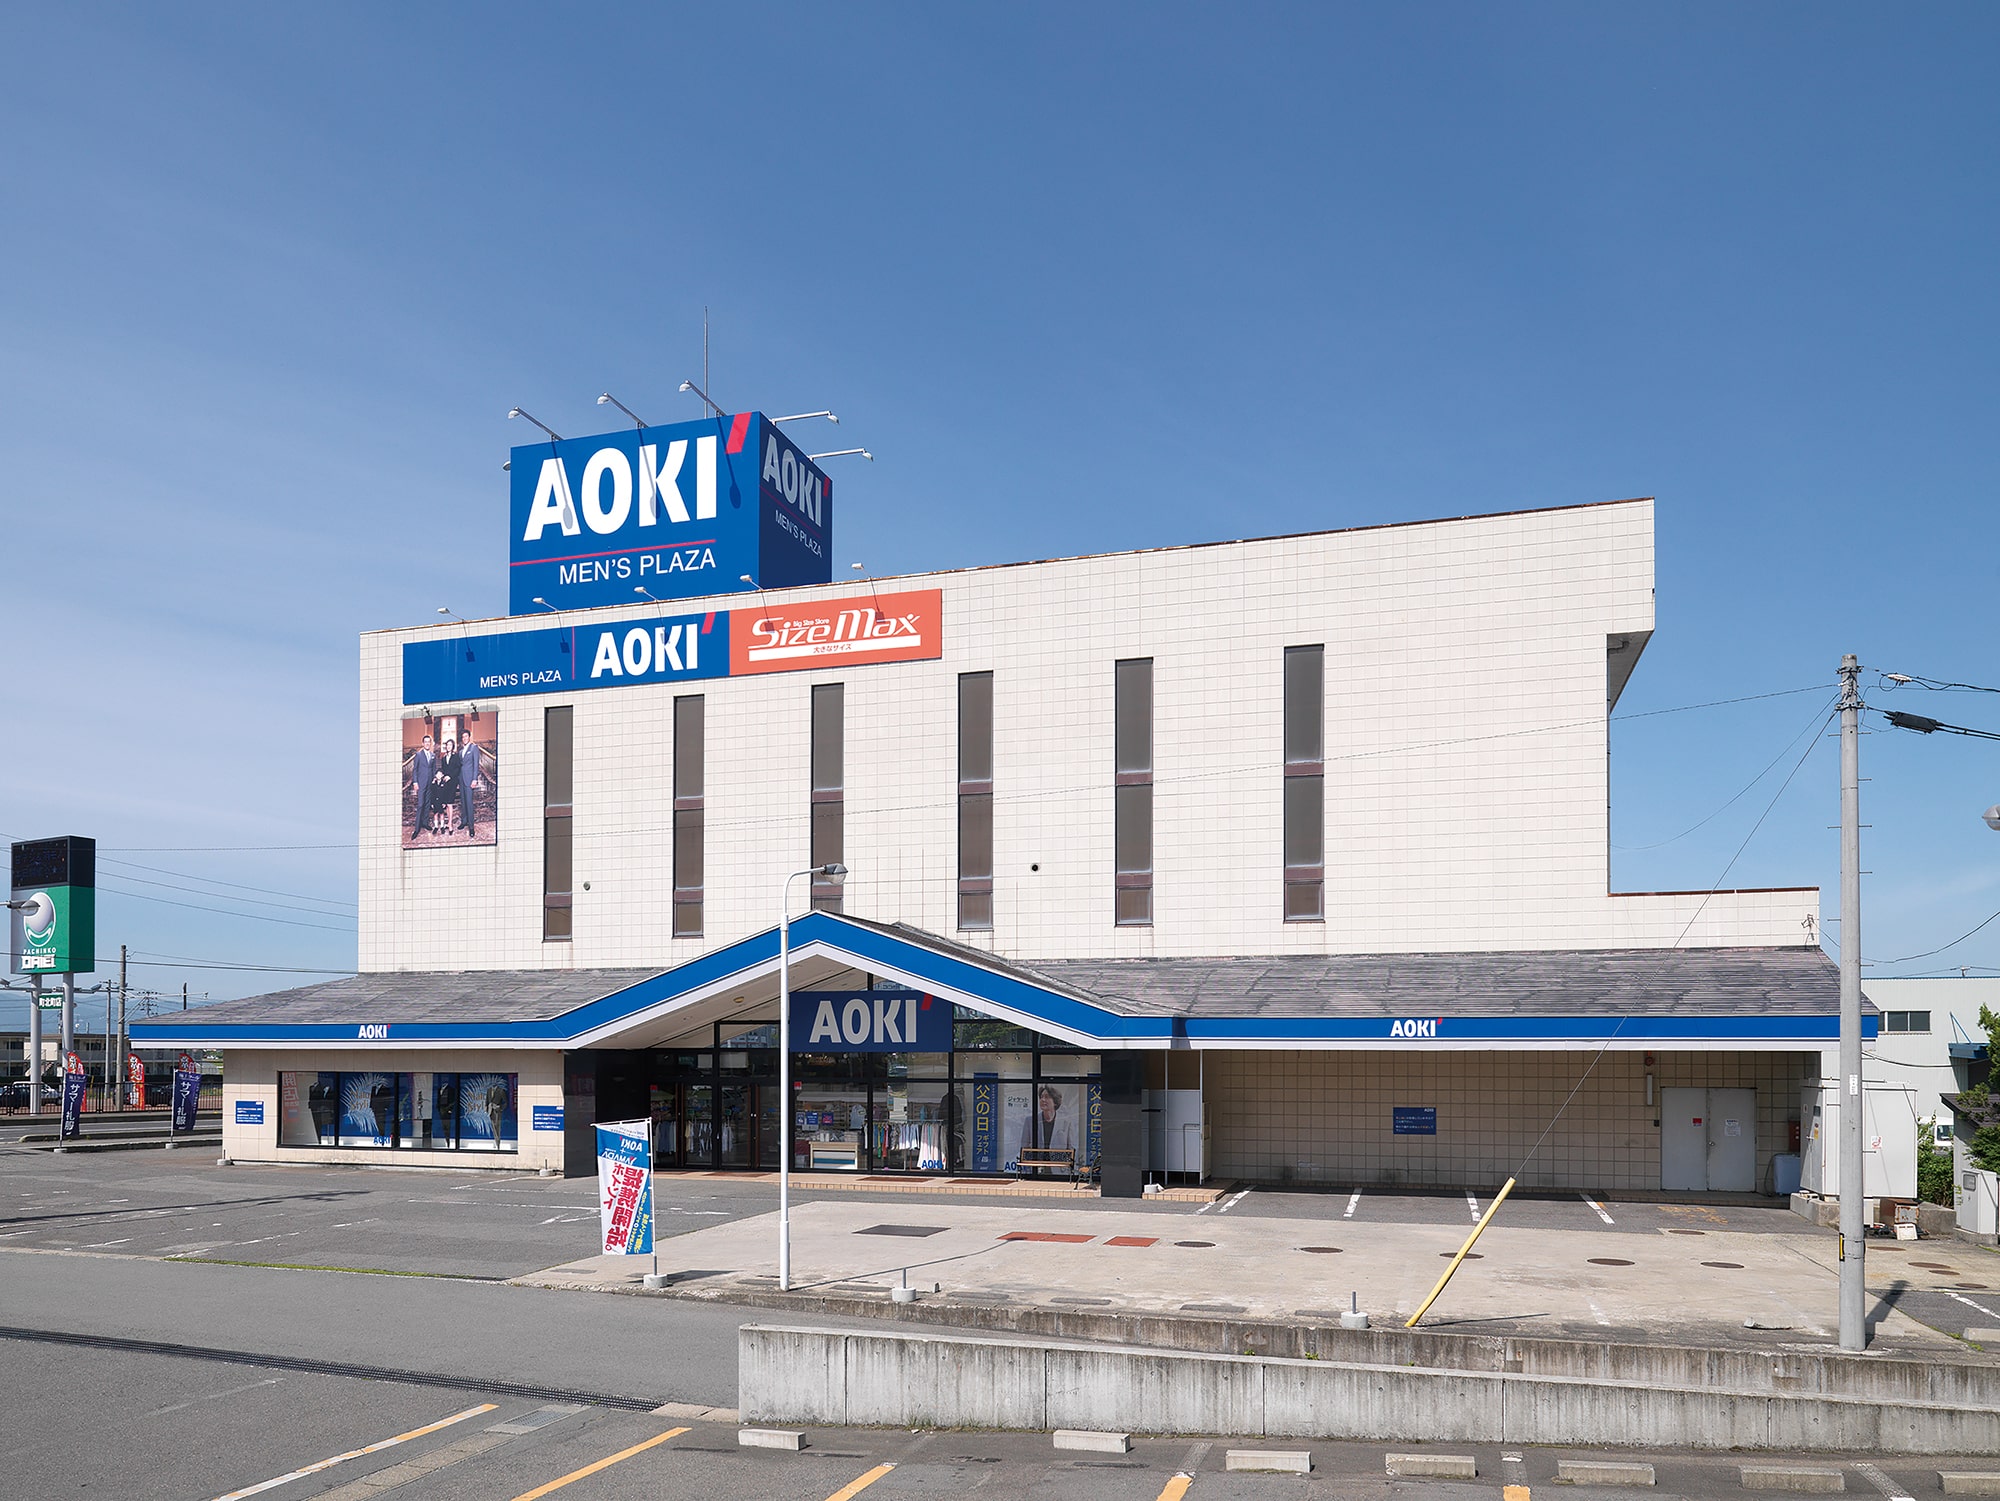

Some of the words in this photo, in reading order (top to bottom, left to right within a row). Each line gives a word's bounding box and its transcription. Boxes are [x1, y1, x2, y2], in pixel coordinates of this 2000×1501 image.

[523, 434, 718, 542] AOKI
[763, 433, 822, 527] AOKI
[775, 509, 800, 539] MEN'S
[799, 530, 823, 559] PLAZA
[559, 557, 632, 585] MEN'S
[639, 548, 716, 576] PLAZA
[748, 616, 831, 649] Size
[833, 608, 921, 641] Max
[813, 643, 852, 654] 大きなサイズ
[590, 623, 698, 679] AOKI
[480, 675, 519, 689] MEN'S
[522, 670, 562, 685] PLAZA
[358, 1024, 387, 1039] AOKI
[809, 999, 917, 1044] AOKI
[1390, 1019, 1436, 1038] AOKI
[976, 1084, 991, 1132] 父の日
[921, 1160, 943, 1169] AOKI
